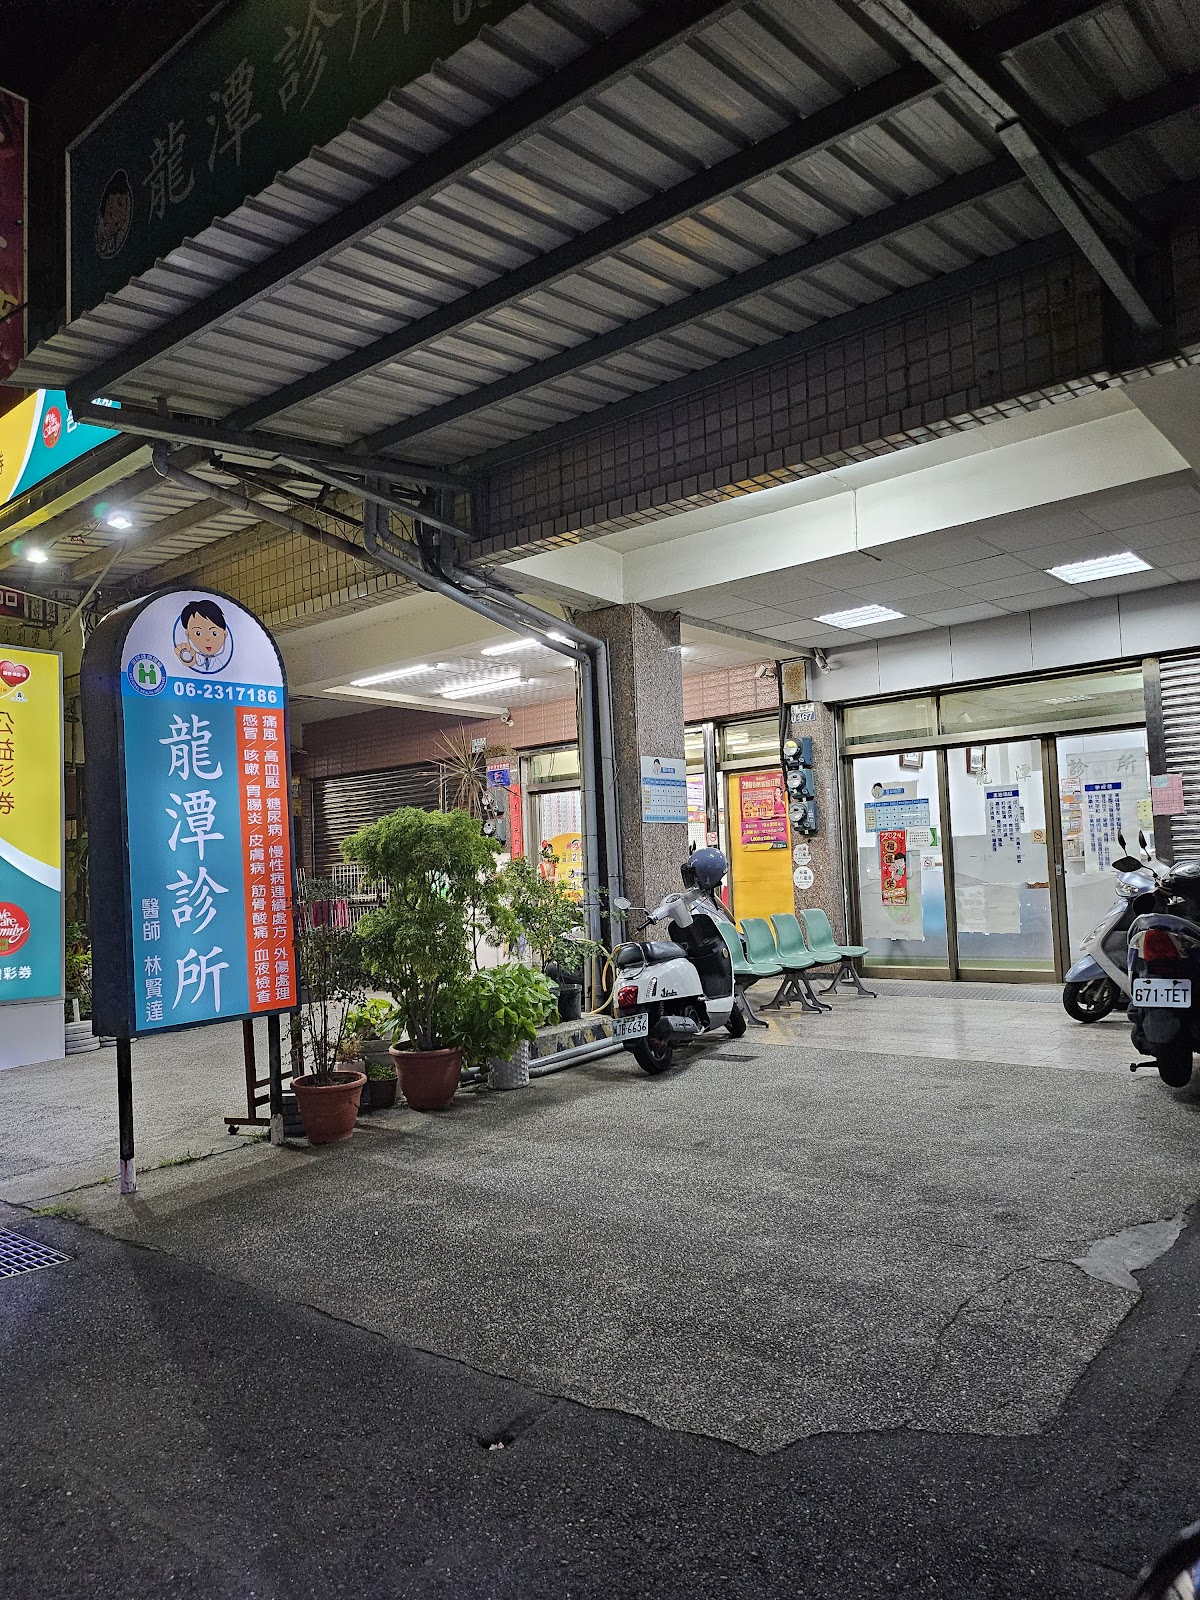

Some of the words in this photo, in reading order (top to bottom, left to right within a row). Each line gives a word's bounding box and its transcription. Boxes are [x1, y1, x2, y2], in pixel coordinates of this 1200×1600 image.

[173, 681, 277, 703] 06-2317186
[883, 832, 902, 840] 2024
[158, 713, 230, 1013] 龍潭診所
[141, 897, 161, 942] 醫師
[0, 965, 32, 981] 彩券
[143, 954, 164, 1023] 林賢達
